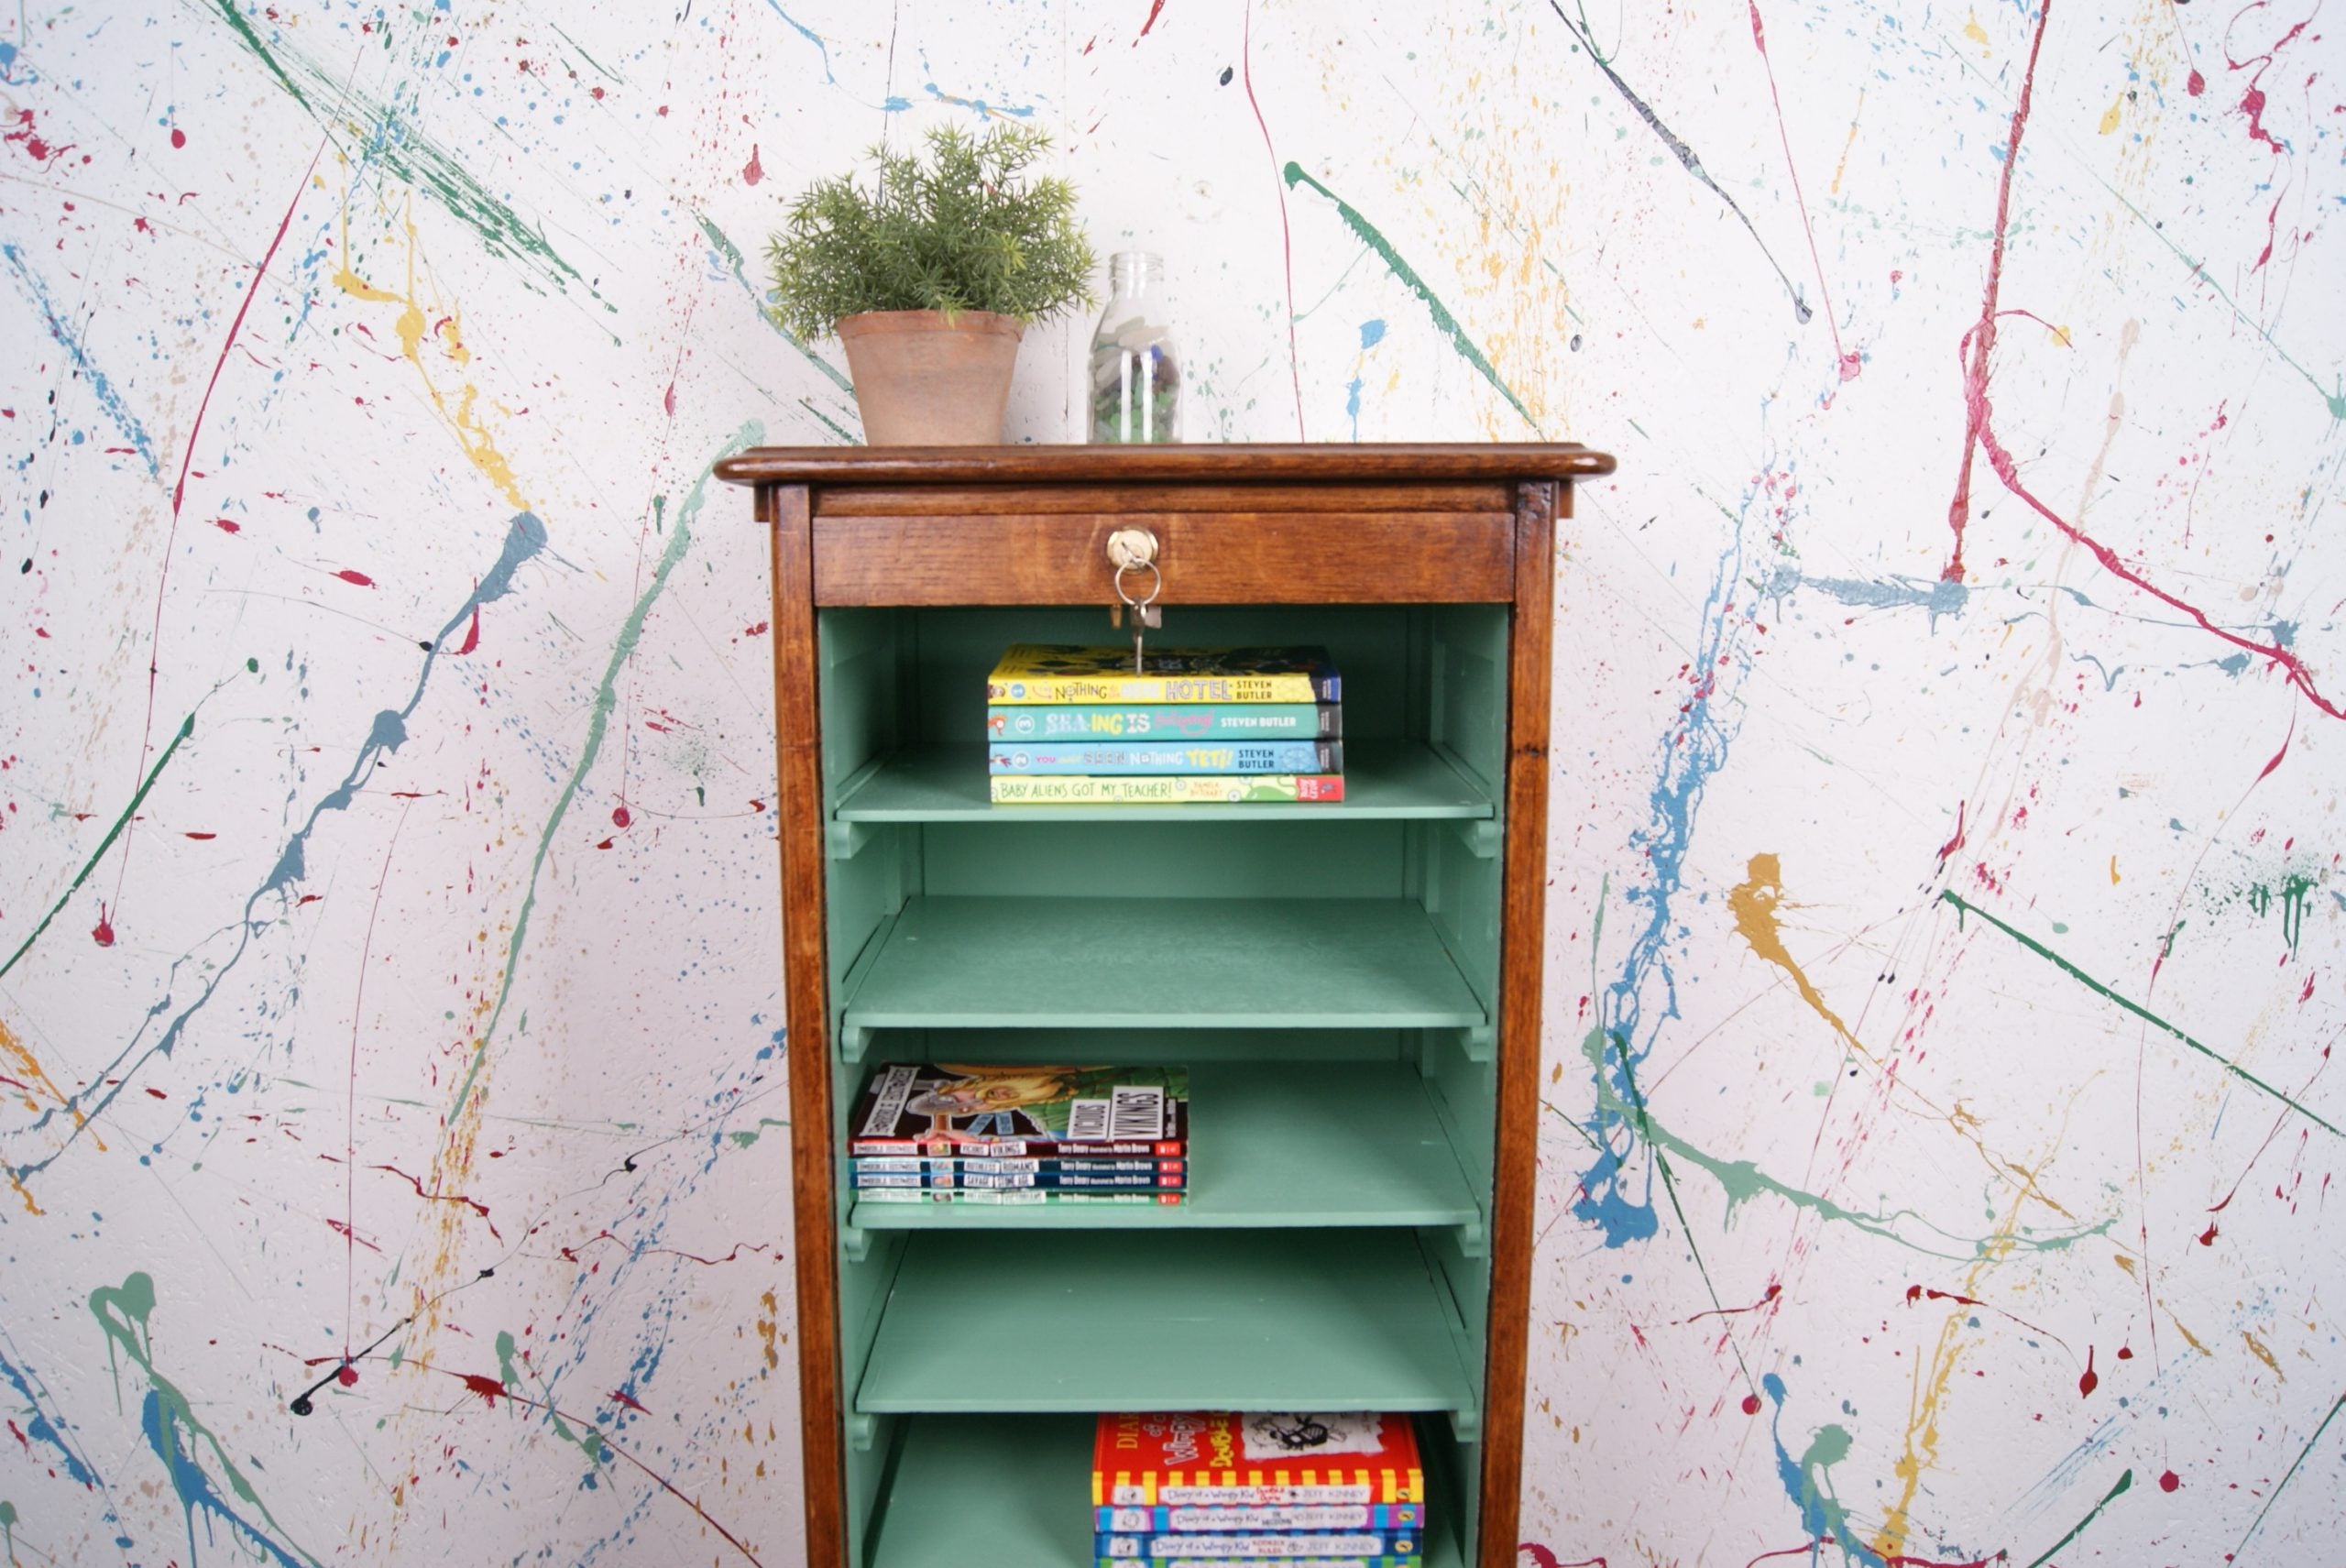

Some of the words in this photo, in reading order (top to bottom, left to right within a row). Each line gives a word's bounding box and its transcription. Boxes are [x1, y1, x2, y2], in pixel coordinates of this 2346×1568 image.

[1056, 682, 1107, 700] NOTHING
[1166, 680, 1232, 700] HOTEL
[1237, 681, 1272, 689] STEVEN
[1237, 691, 1272, 699] BUTLER
[1126, 712, 1151, 734] IS
[1221, 717, 1257, 727] STEVEN
[1259, 717, 1297, 727] BUTLER
[1084, 752, 1125, 765] SEEN
[1129, 751, 1183, 766] NOTHING
[1239, 750, 1274, 758] STEVEN
[1239, 760, 1274, 769] BUTLER
[1001, 784, 1029, 798] BABY
[1031, 784, 1069, 797] ALIENS
[1071, 783, 1095, 797] GOT
[1102, 784, 1116, 797] MY
[1122, 783, 1172, 798] TEACHER!
[1072, 1104, 1105, 1135] VICIOUS
[1113, 1092, 1159, 1136] VIKINGS
